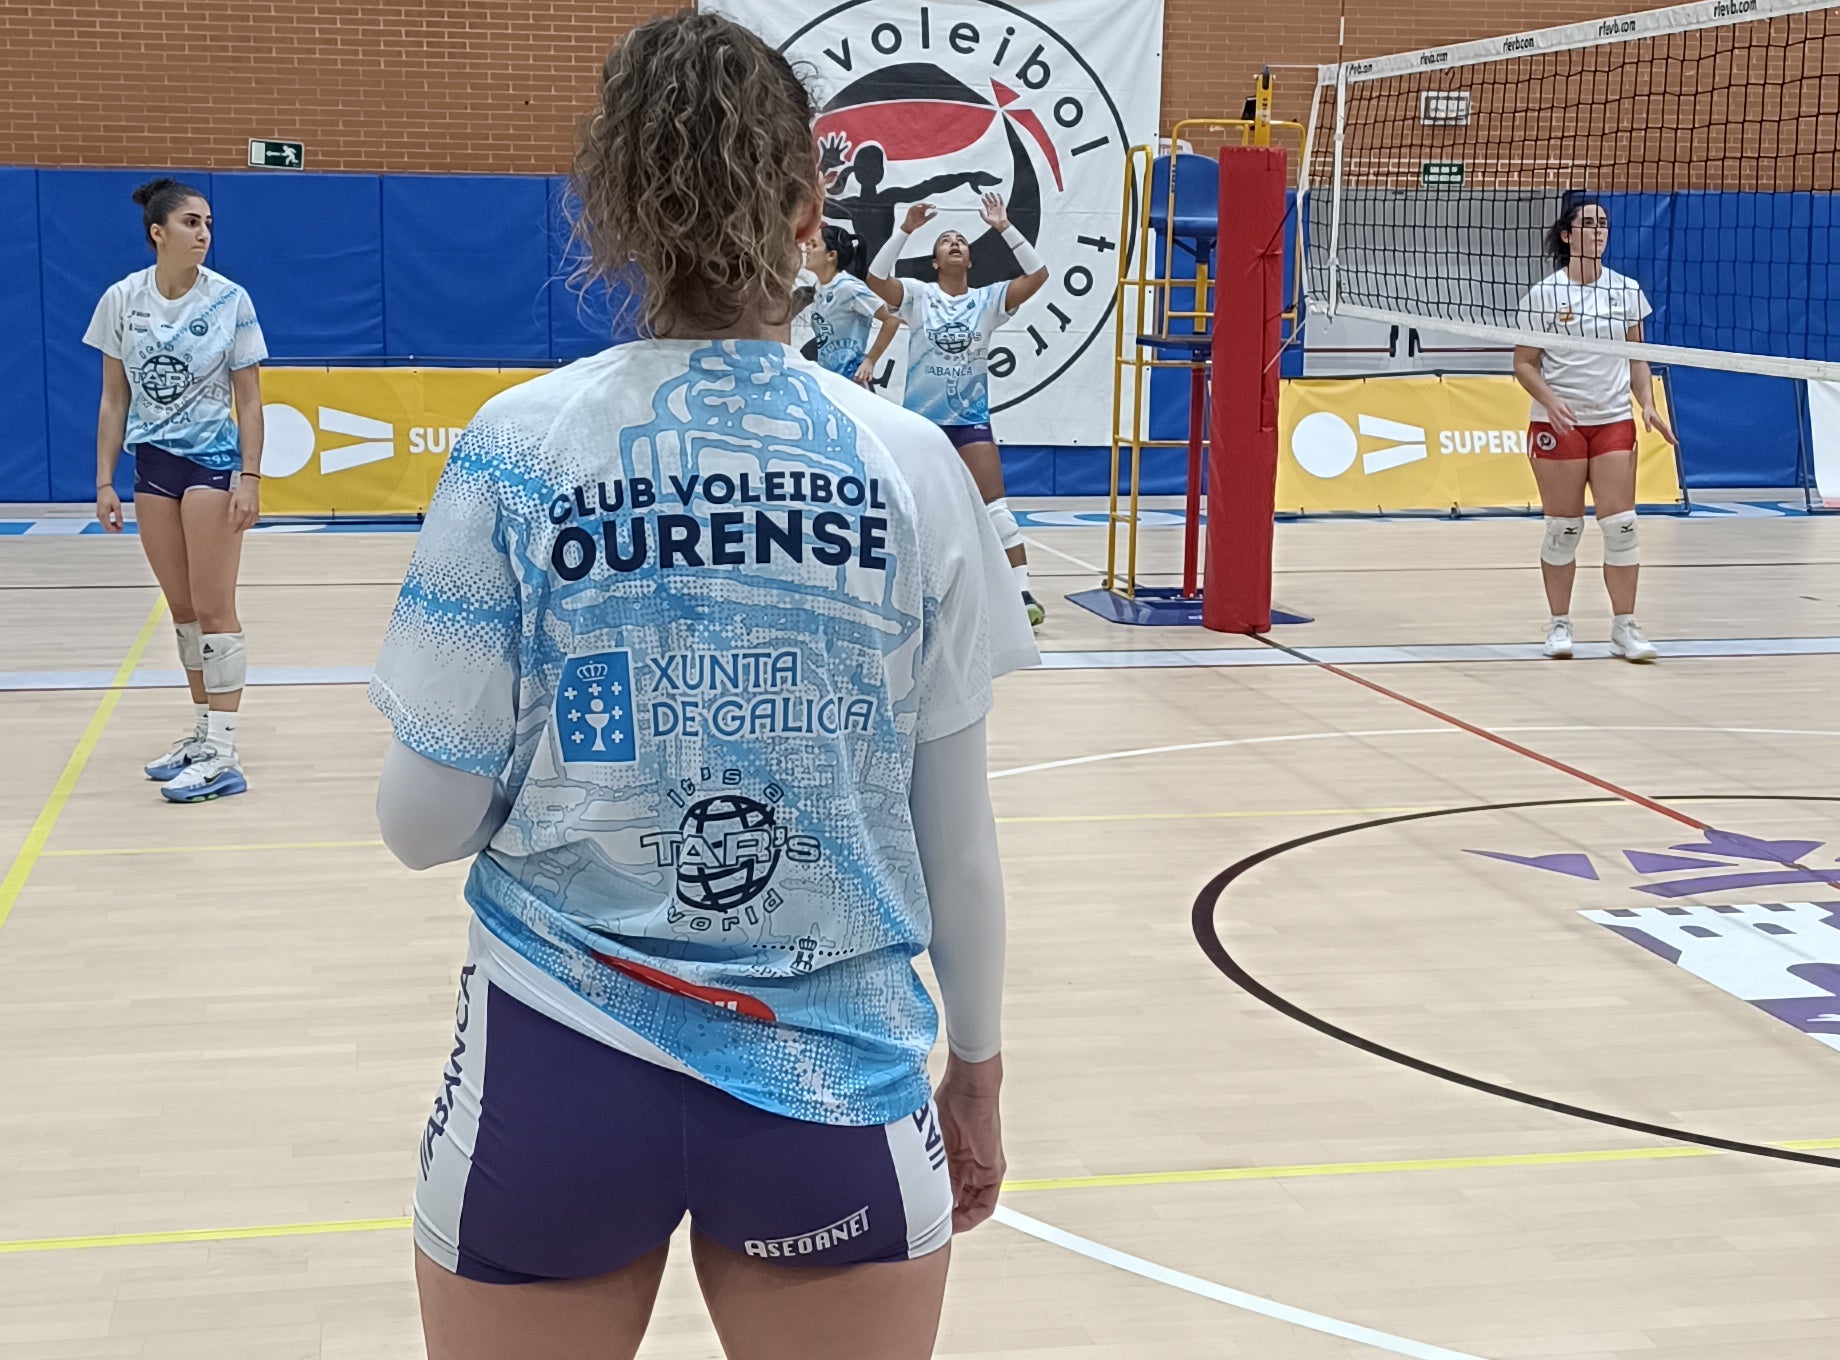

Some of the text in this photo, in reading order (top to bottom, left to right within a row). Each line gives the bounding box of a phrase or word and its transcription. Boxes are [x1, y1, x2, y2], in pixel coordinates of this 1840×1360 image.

[823, 6, 1109, 157] voleibol
[549, 471, 886, 525] CLUB VOLEIBOL
[551, 509, 888, 582] OURENSE
[650, 651, 798, 692] XUNTA
[652, 695, 874, 737] DE GALICIA
[763, 783, 784, 804] a
[640, 826, 821, 869] TAR'S
